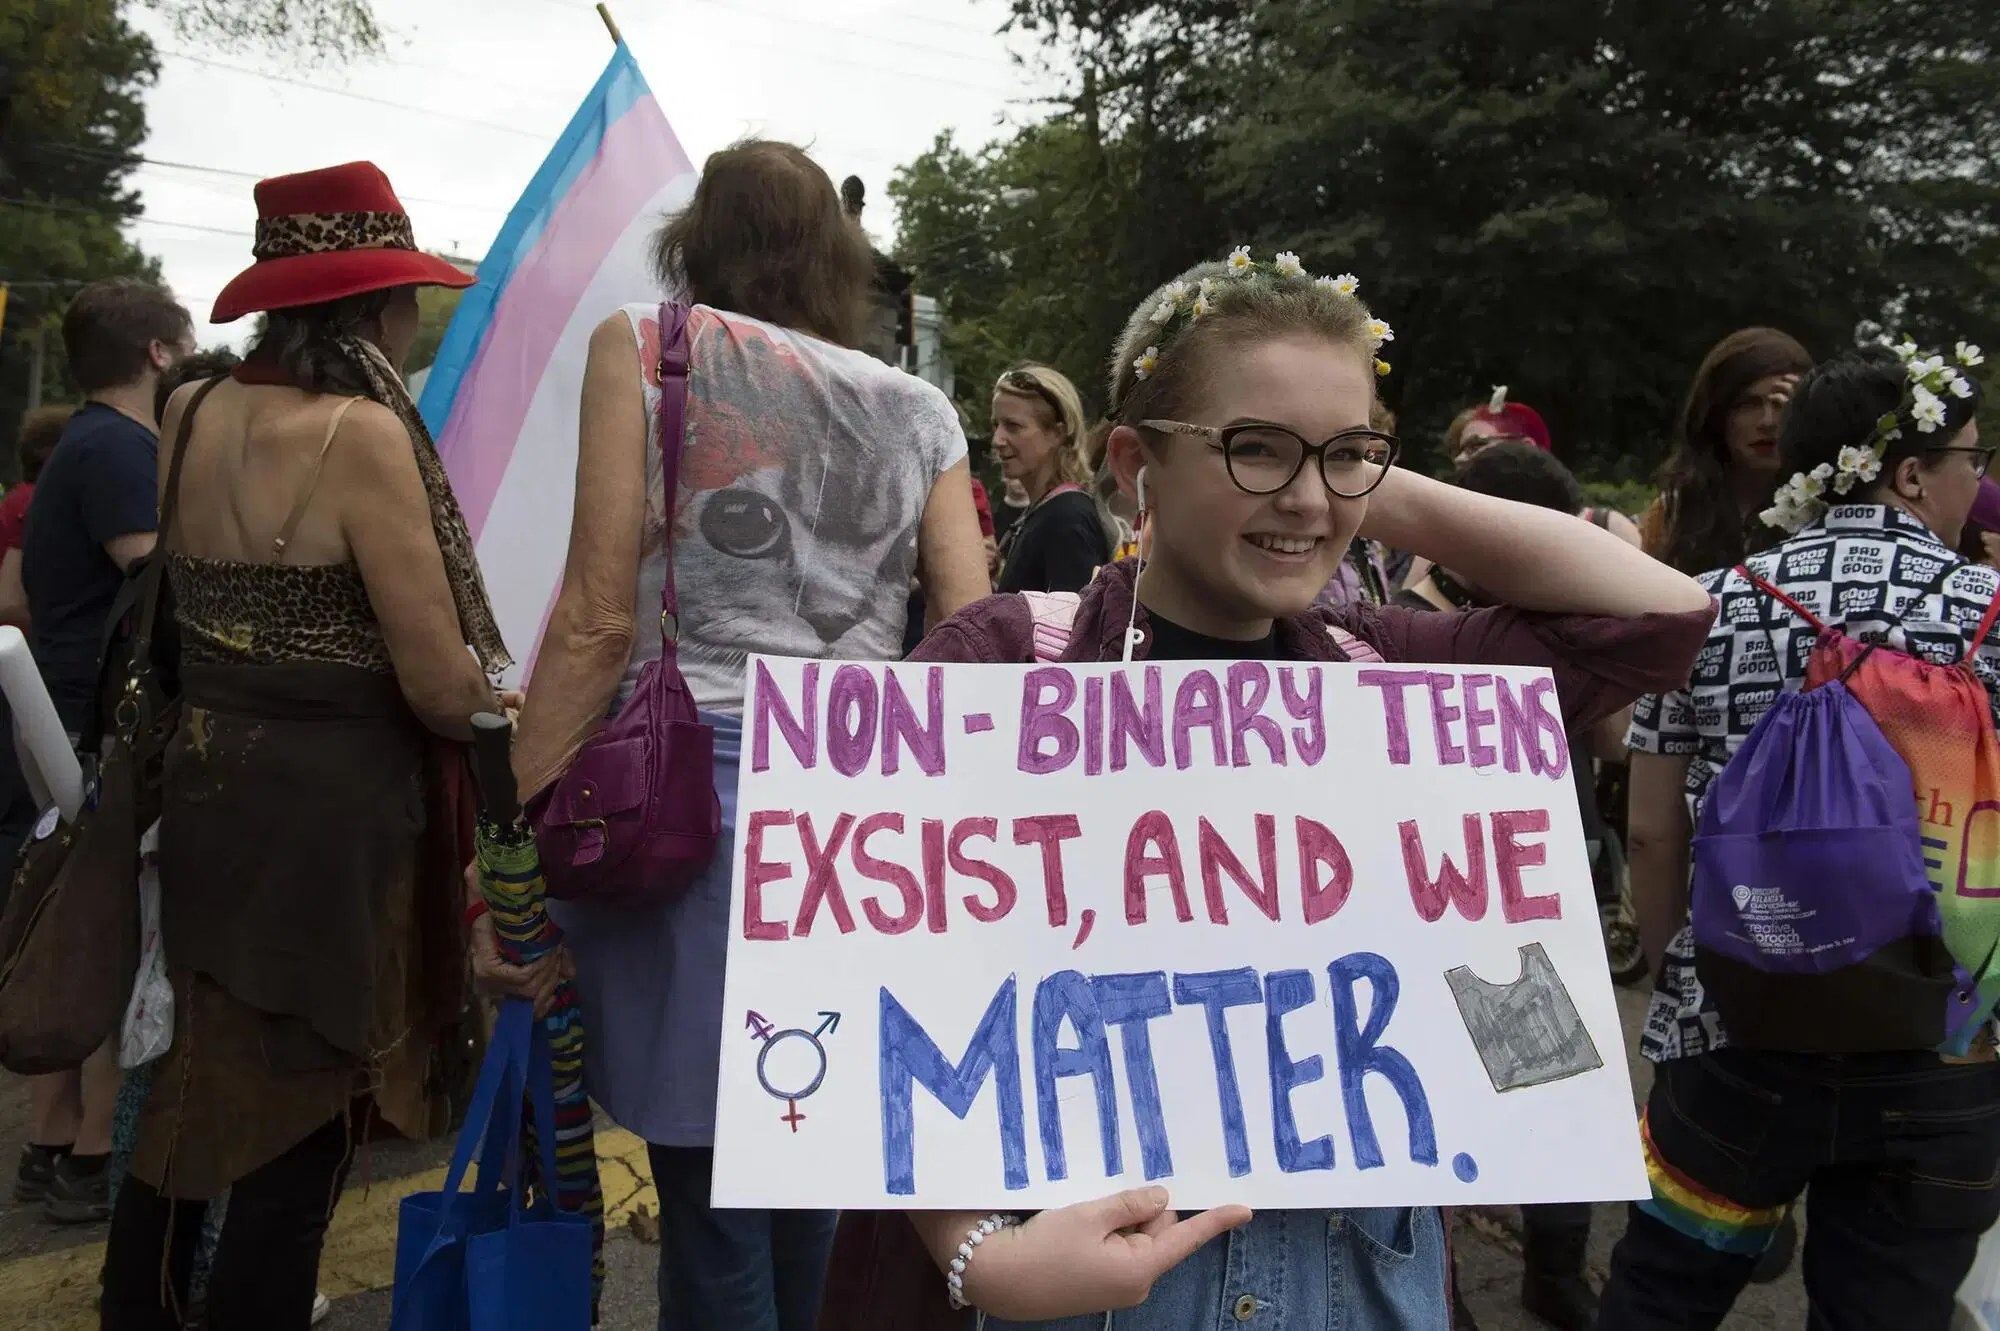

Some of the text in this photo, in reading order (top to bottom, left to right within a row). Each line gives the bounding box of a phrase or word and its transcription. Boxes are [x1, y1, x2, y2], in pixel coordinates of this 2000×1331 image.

[1834, 507, 1876, 519] GOOD
[1787, 548, 1828, 562] GOOD
[1848, 546, 1880, 556] BAD
[1901, 553, 1945, 569] GOOD
[1789, 564, 1821, 577] BAD
[1841, 564, 1882, 575] GOOD
[1901, 570, 1935, 583] BAD
[1839, 587, 1879, 601] GOOD
[1952, 580, 1994, 597] GOOD
[1738, 660, 1778, 675] GOOD
[1735, 690, 1775, 704] GOOD
[1358, 666, 1569, 780] TEENS
[743, 809, 1561, 949] EXSIST, AND WE
[878, 951, 1479, 1196] MATTER.
